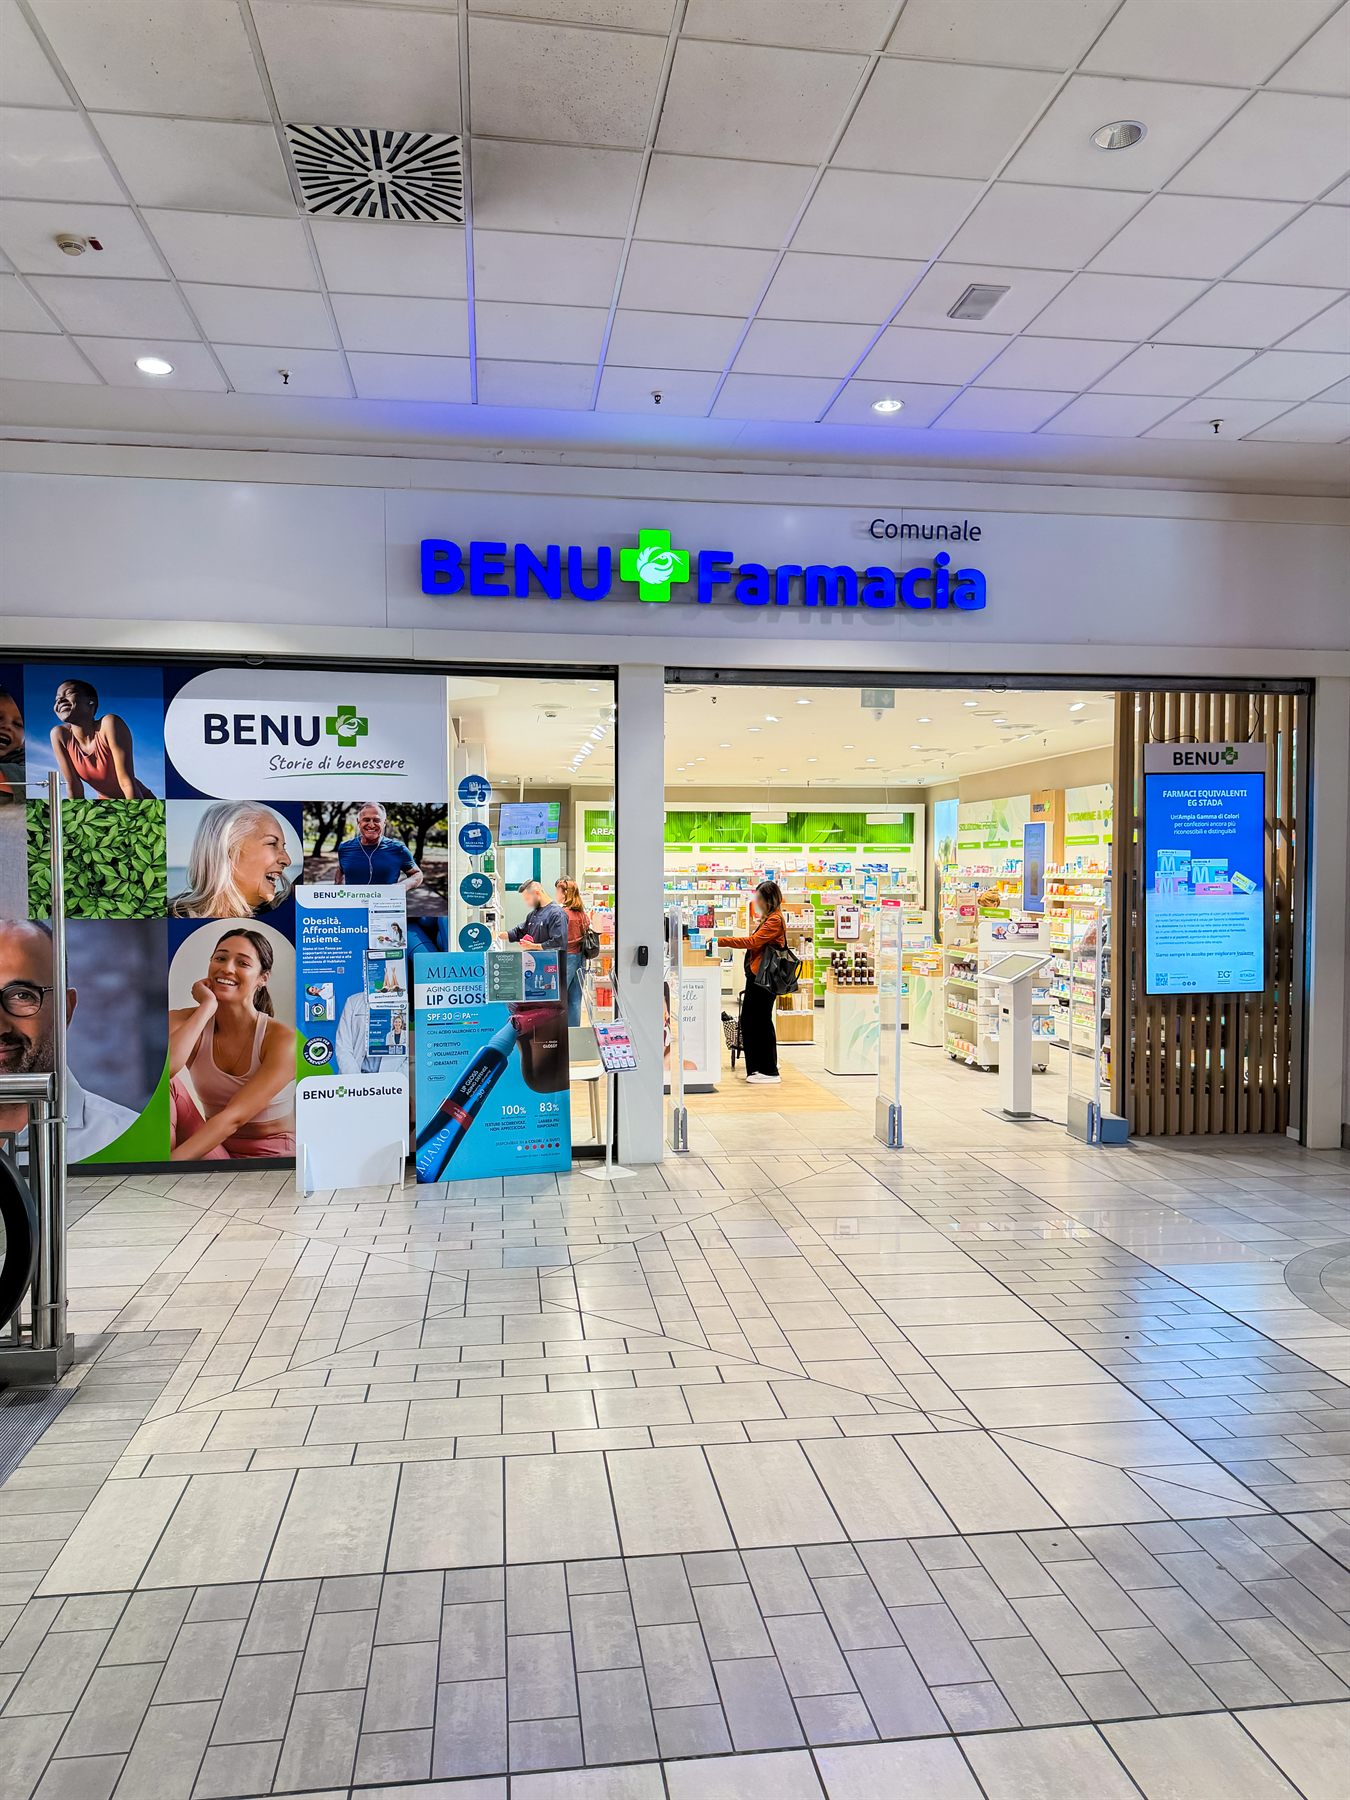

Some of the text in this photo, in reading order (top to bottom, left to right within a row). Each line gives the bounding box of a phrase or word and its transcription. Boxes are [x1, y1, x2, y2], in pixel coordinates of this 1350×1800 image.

[870, 519, 982, 542] Comunale
[421, 539, 987, 611] BENU Farmacia
[204, 713, 320, 747] BENU
[268, 754, 405, 771] Storie di benessere
[1173, 752, 1219, 766] BENU
[1162, 789, 1247, 799] FARMACI EQUIVALENTI
[1187, 799, 1197, 807] EG
[590, 827, 615, 836] AREA
[313, 891, 382, 900] BENU Farmacia
[302, 917, 342, 926] Obesità.
[302, 925, 369, 935] Affrontiamola
[302, 935, 341, 944] insieme.
[426, 984, 483, 994] AGING DEFENSE
[426, 994, 444, 1006] LIP
[448, 993, 487, 1004] GLOSS
[427, 1013, 441, 1022] SPF
[442, 1012, 453, 1021] 30
[303, 1086, 403, 1101] BENU HubSalute
[501, 1105, 527, 1116] 100%
[539, 1102, 560, 1113] 83%
